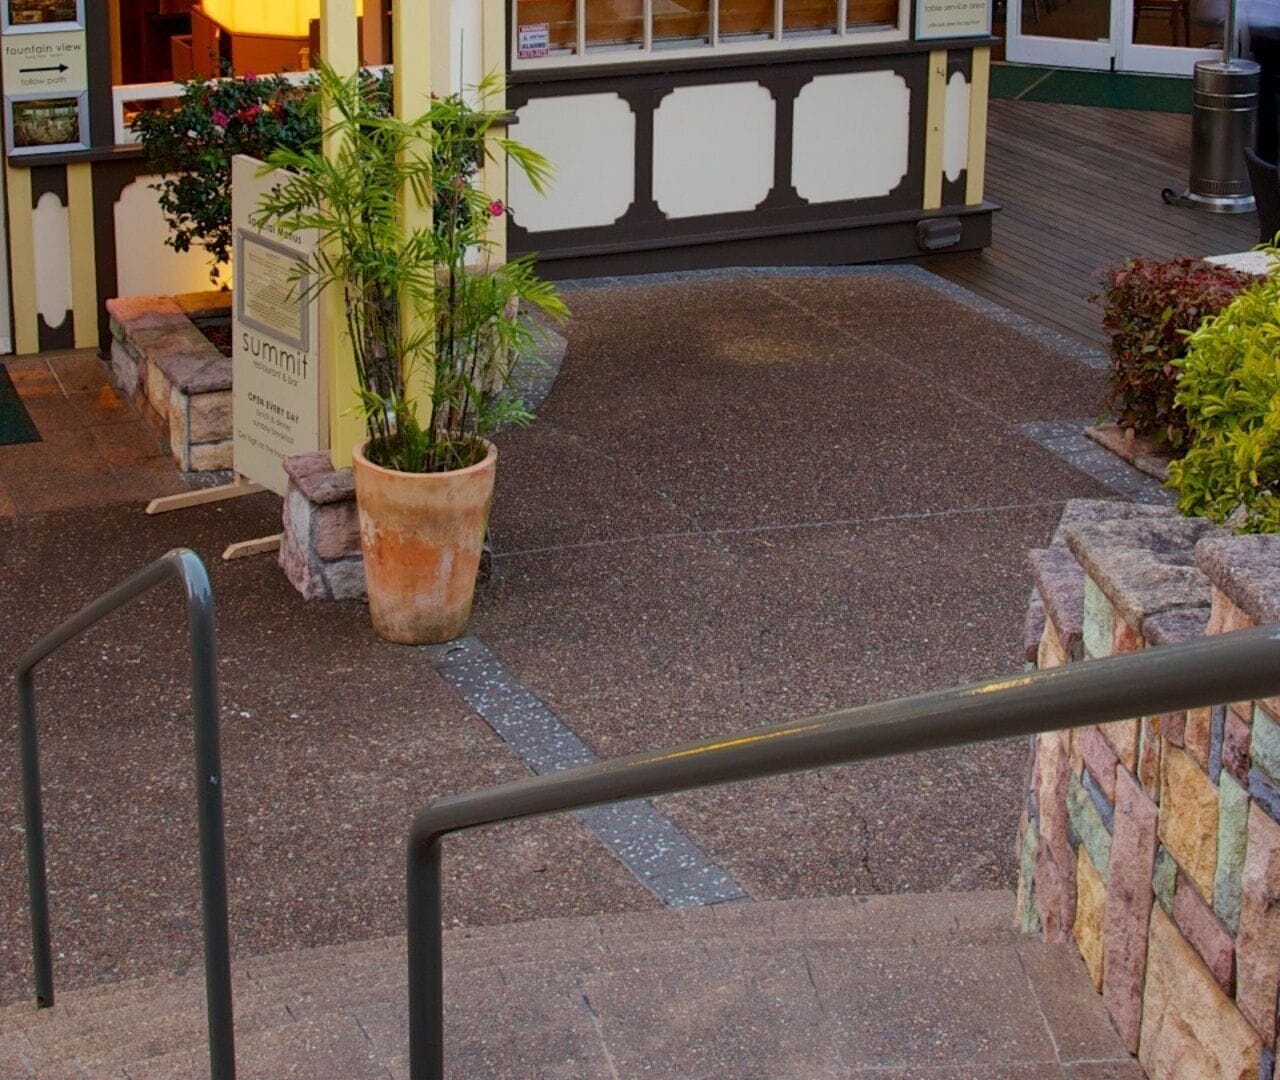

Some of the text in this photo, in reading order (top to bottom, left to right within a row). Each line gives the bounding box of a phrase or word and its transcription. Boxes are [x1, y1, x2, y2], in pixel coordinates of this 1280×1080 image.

[6, 44, 53, 56] fountain
[56, 42, 81, 52] view
[243, 332, 308, 380] summit
[248, 392, 299, 424] OPEN EVERY DAY
